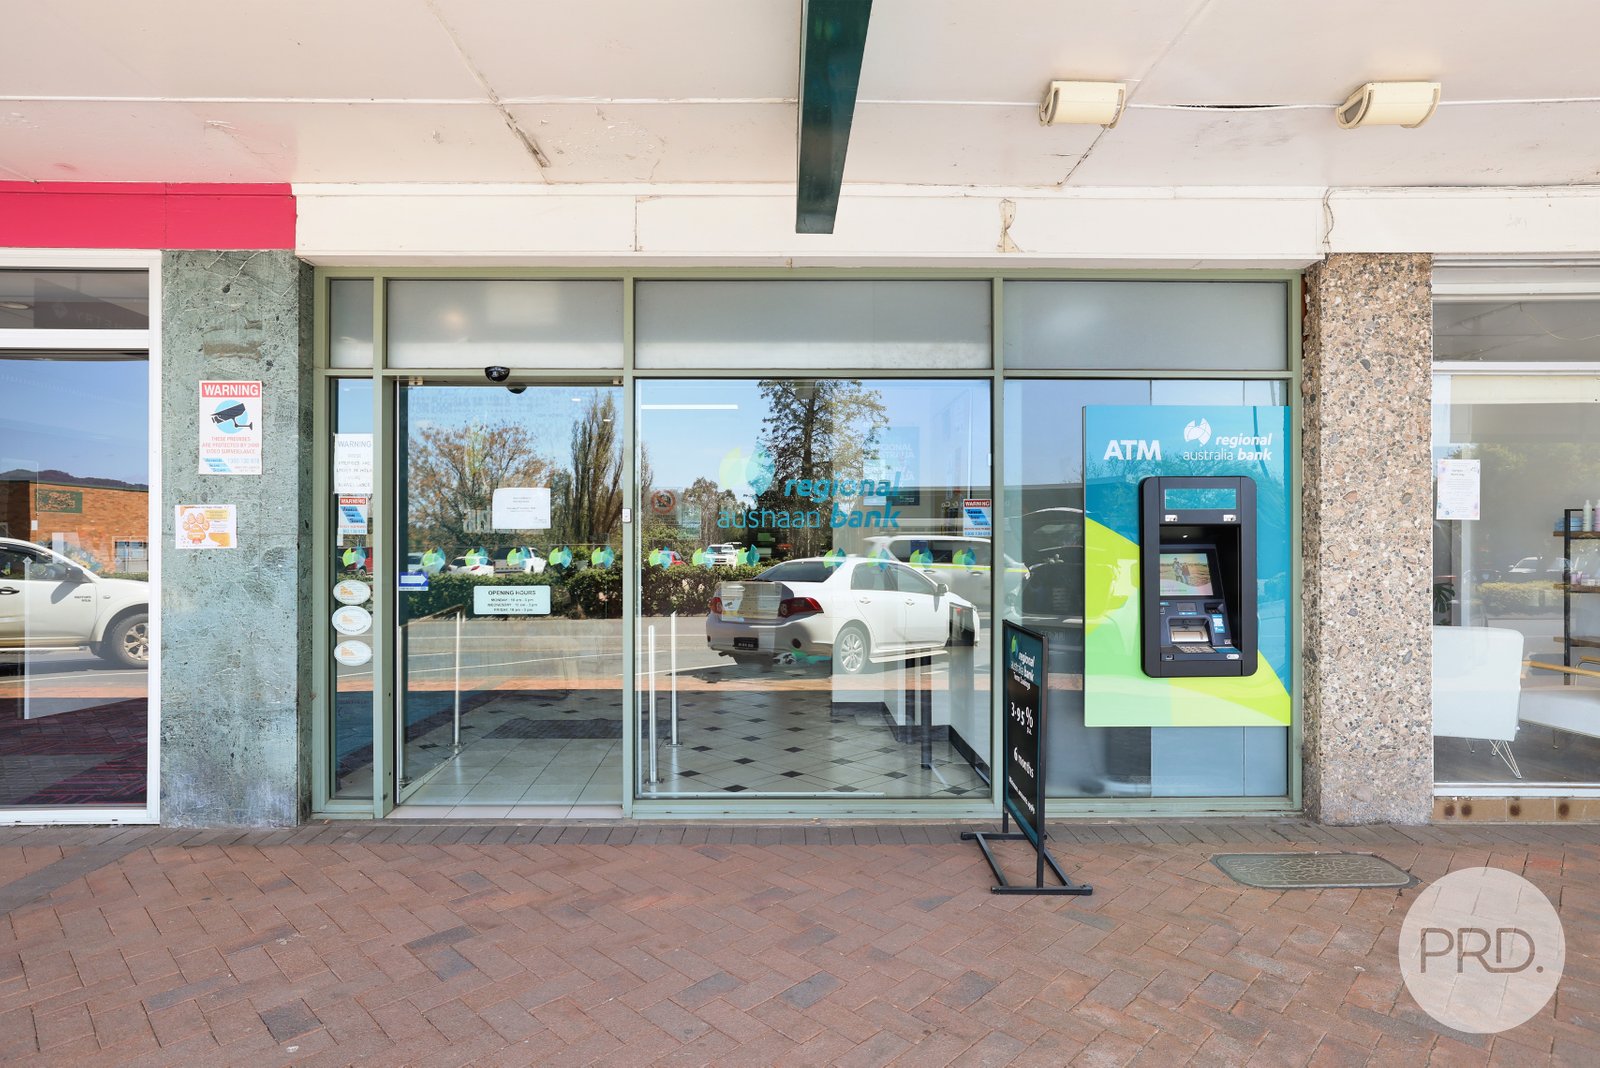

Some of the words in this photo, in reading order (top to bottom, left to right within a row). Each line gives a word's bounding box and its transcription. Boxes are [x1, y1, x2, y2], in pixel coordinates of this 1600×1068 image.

[204, 384, 259, 396] WARNING
[338, 440, 371, 448] WARNING
[1216, 433, 1272, 448] regional
[1104, 439, 1161, 460] ATM
[1183, 448, 1233, 461] australia
[1237, 448, 1272, 461] bank
[784, 471, 901, 503] regional
[830, 503, 901, 528] bank
[1018, 651, 1035, 667] regional
[1023, 665, 1034, 682] bank
[1013, 746, 1018, 762] 6
[1018, 754, 1034, 778] months
